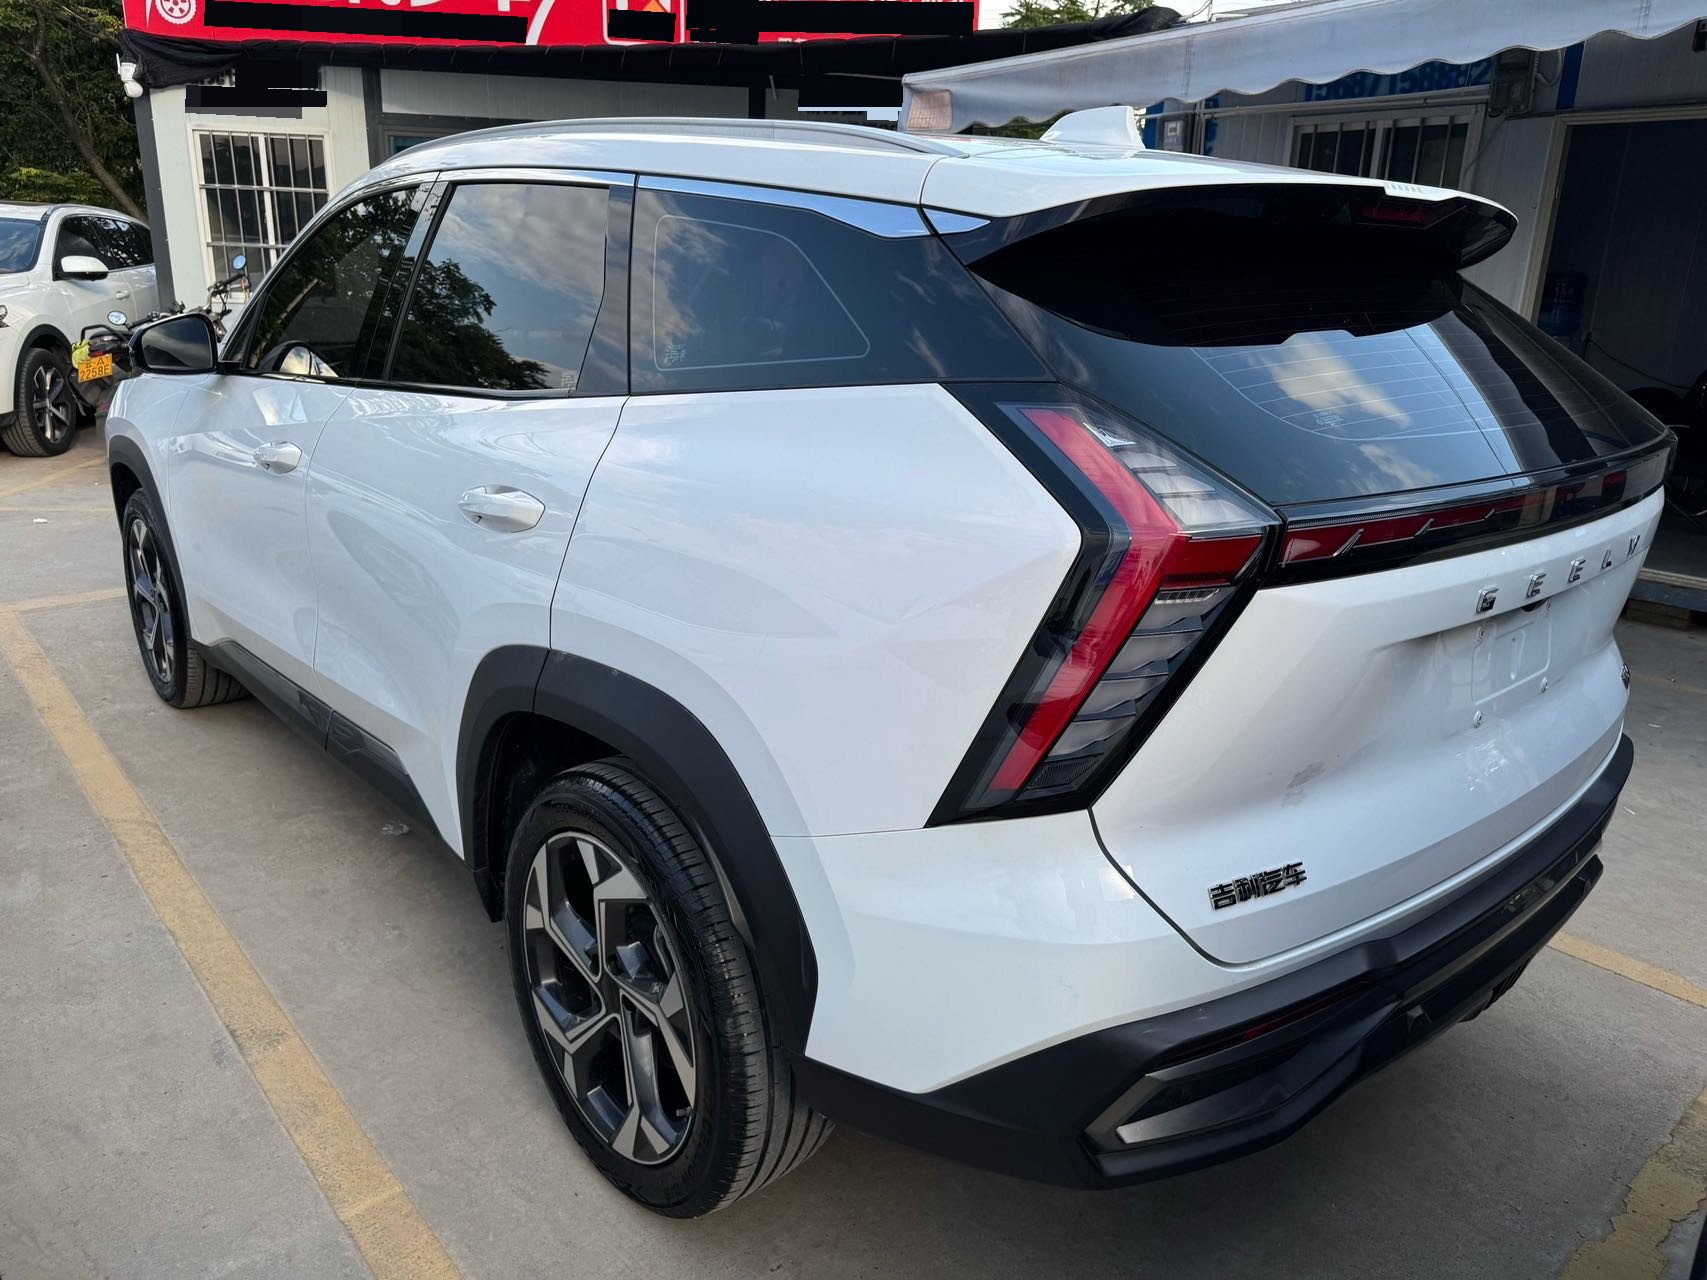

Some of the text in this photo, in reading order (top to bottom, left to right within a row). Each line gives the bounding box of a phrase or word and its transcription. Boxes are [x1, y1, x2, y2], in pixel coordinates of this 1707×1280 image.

[1475, 534, 1640, 614] GEELY
[1208, 861, 1307, 910] 吉利汽车
